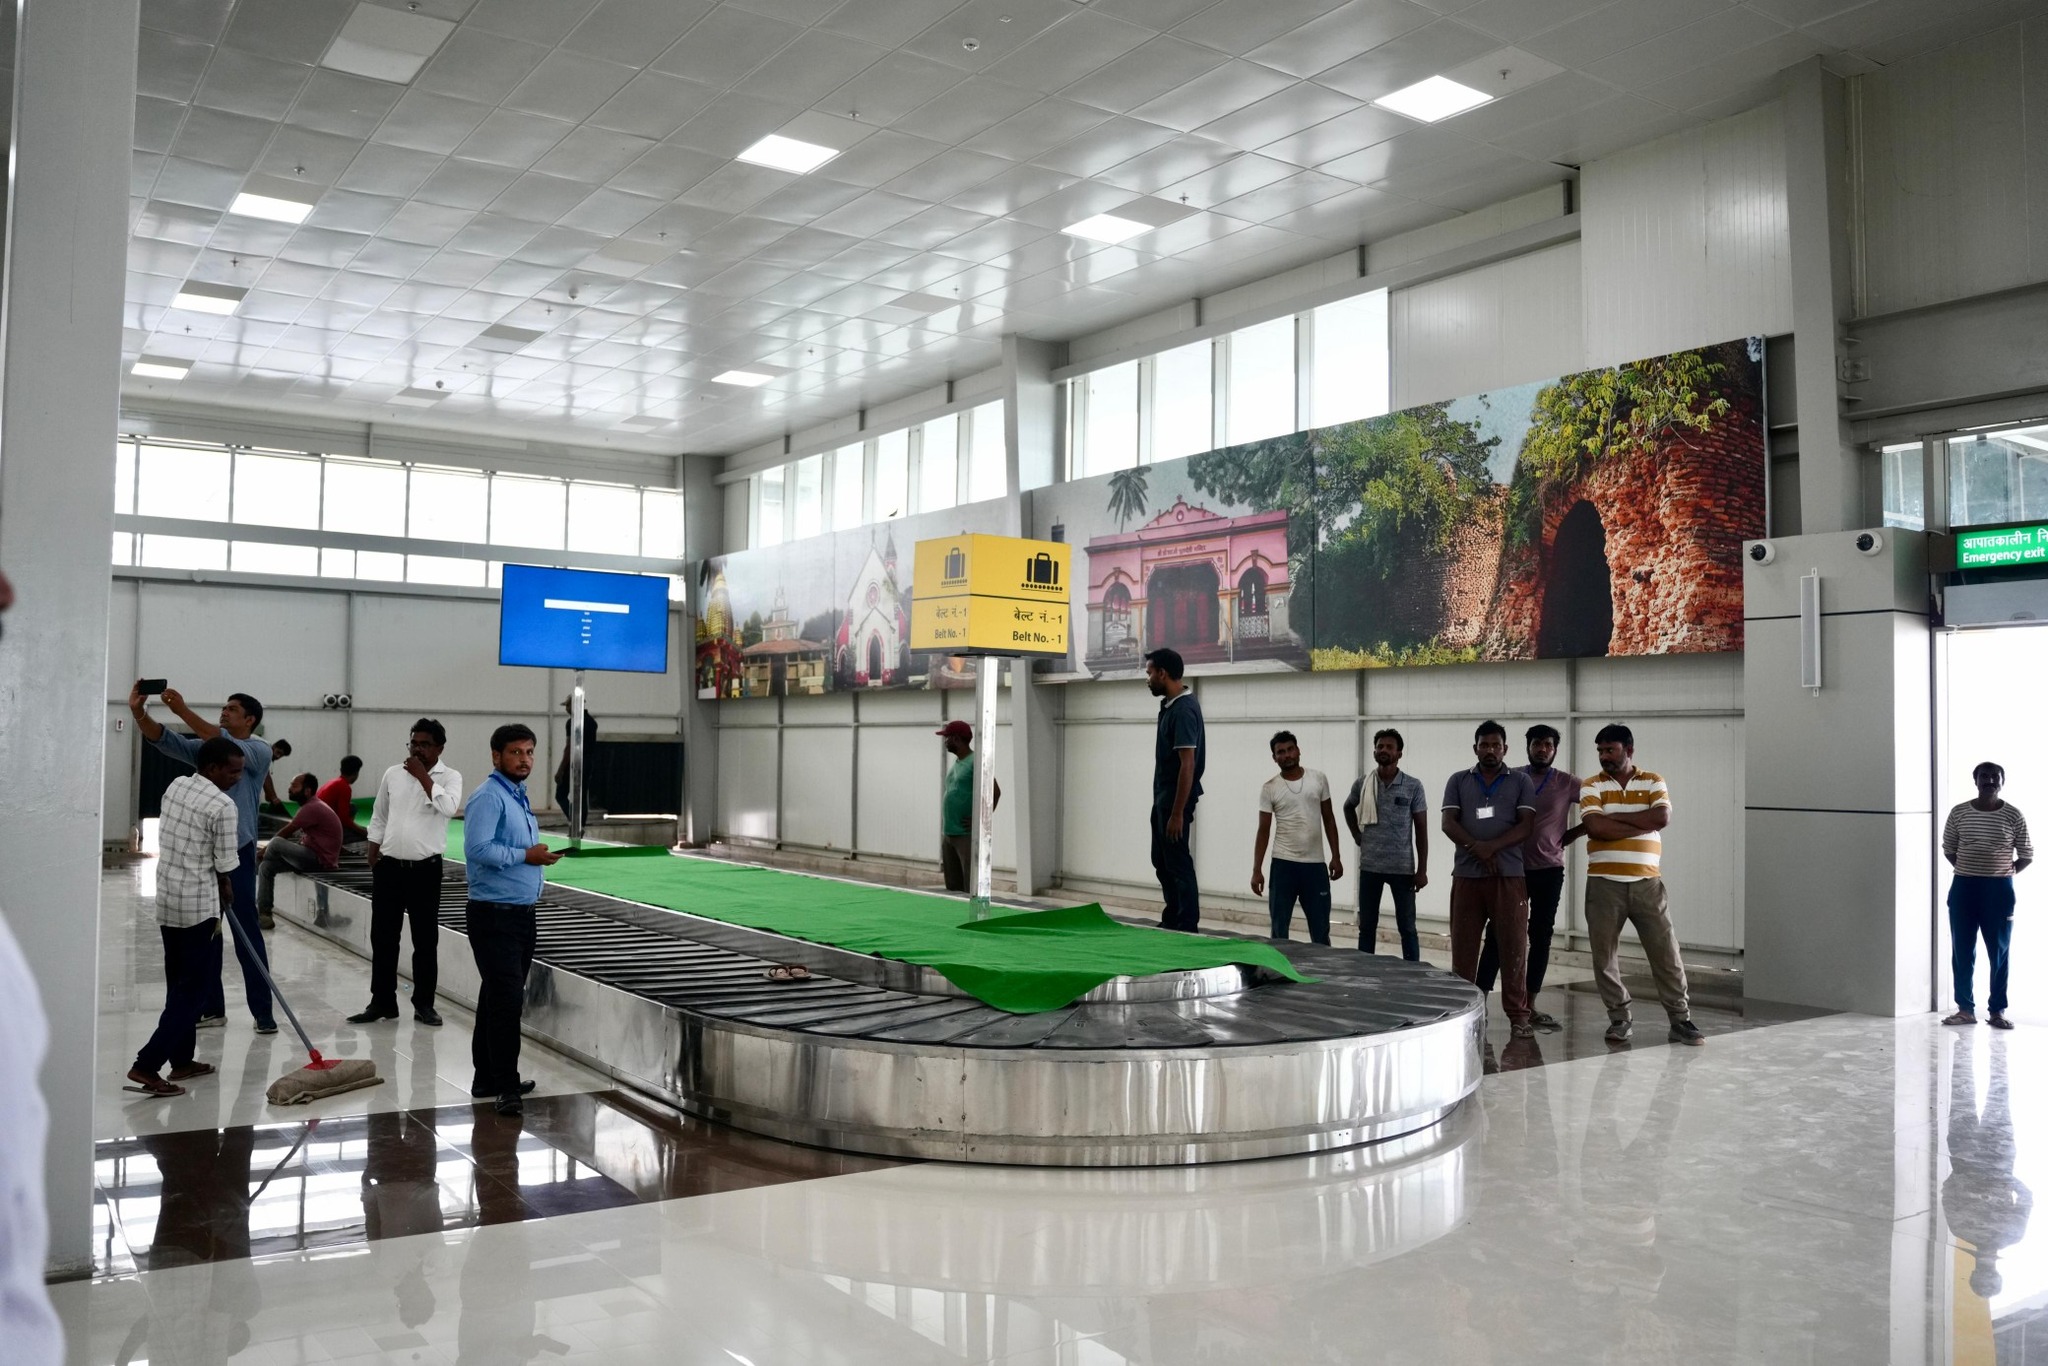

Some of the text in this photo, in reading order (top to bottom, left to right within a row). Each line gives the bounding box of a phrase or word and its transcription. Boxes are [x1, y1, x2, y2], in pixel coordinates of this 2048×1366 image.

[1963, 530, 2032, 549] आपातकालीन
[1962, 546, 2046, 564] Emergency exit
[935, 605, 949, 619] बेल्ट
[1013, 606, 1034, 621] बेल्ट
[934, 628, 947, 639] Belt
[947, 628, 958, 639] No.
[1012, 630, 1032, 642] Belt
[1033, 632, 1049, 643] No.
